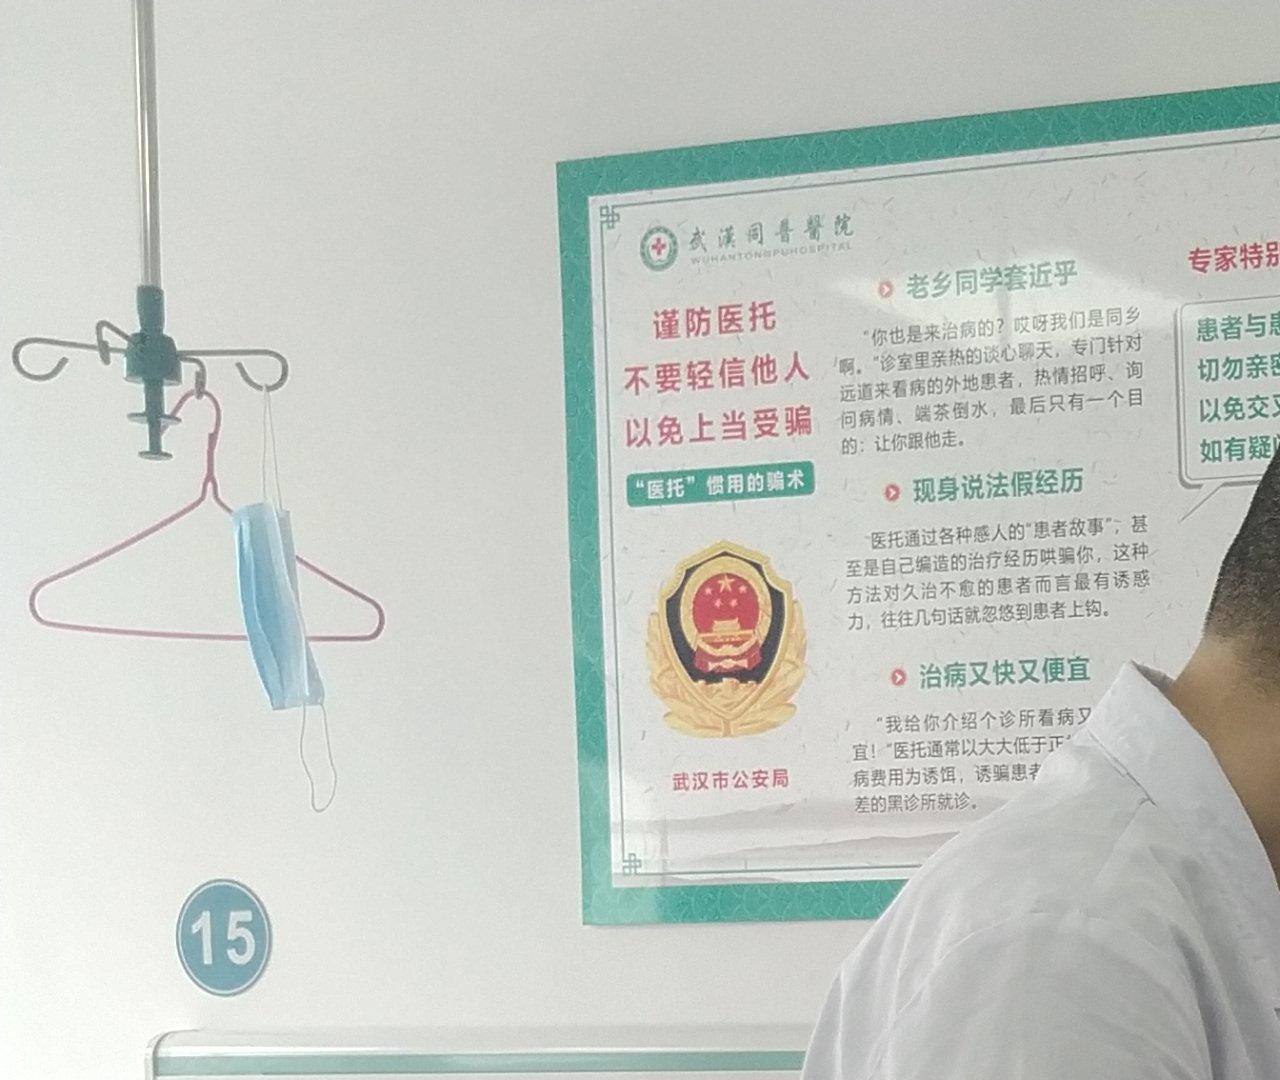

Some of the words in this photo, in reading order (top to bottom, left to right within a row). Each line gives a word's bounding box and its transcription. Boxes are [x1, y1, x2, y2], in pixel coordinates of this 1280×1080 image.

[906, 260, 1078, 300] 老乡同学套近乎
[653, 300, 777, 340] 谨防医托
[624, 351, 810, 397] 不要轻信他人
[625, 405, 813, 448] 以免上当受骗
[913, 468, 1084, 503] 现身说法假经历
[847, 569, 1150, 604] 方法对久治不愈的患者而言最有诱惑
[920, 656, 1091, 689] 治病又快又便宜
[672, 769, 789, 791] 武汉市公安局
[190, 910, 257, 965] 15
